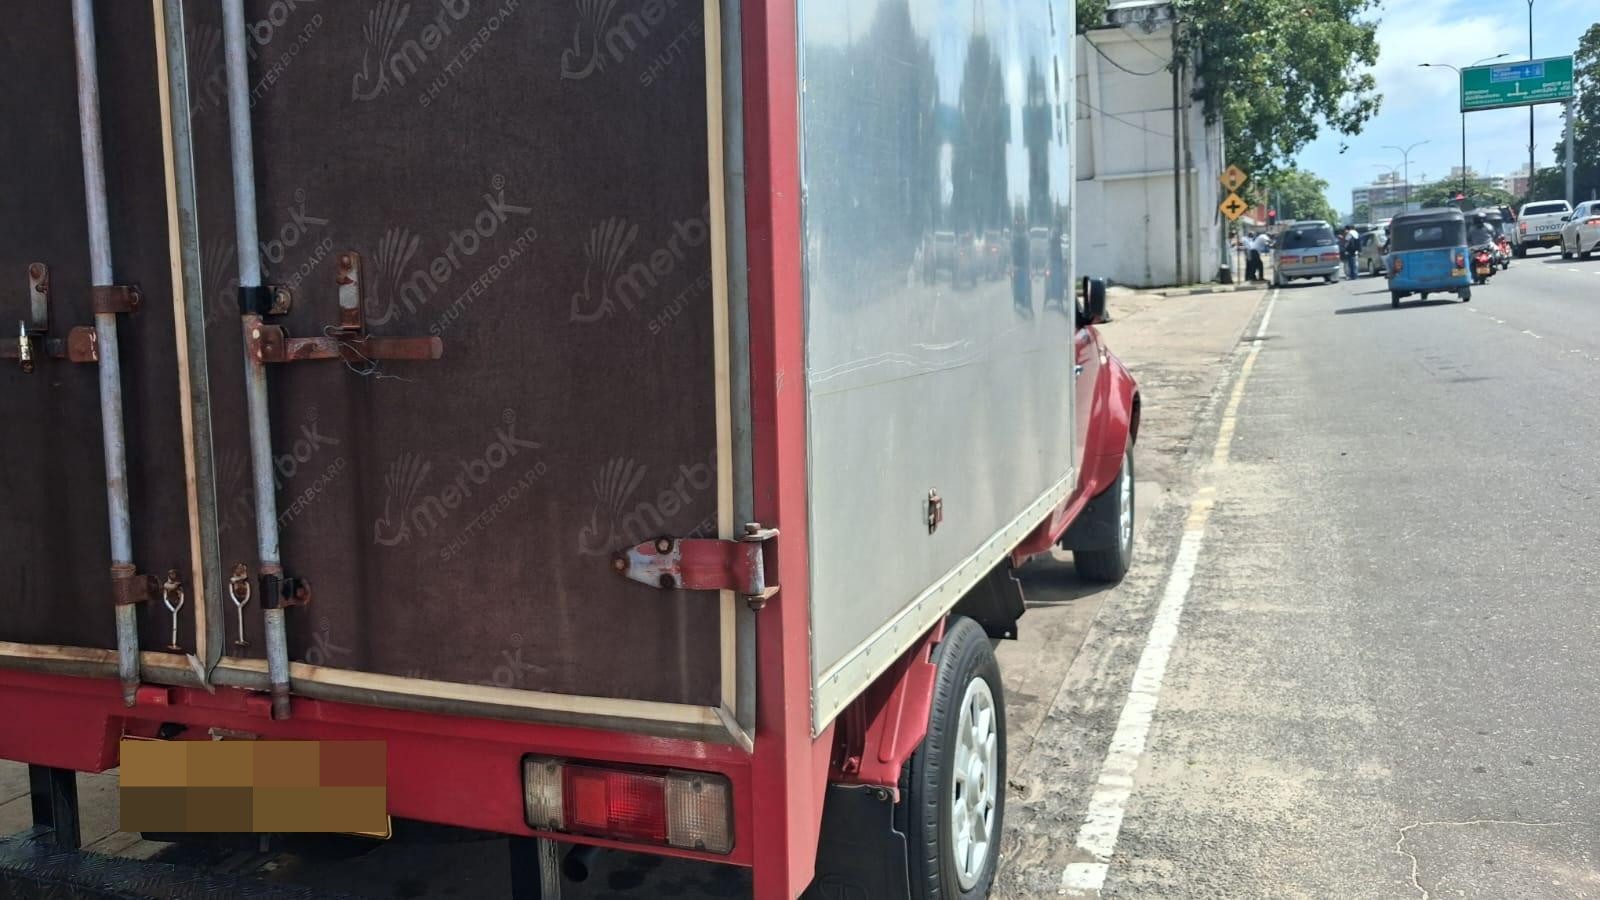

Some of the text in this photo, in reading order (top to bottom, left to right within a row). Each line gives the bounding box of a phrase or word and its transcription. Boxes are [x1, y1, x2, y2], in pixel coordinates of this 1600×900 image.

[249, 13, 323, 108] UTTERBOARD
[430, 226, 538, 337] SHUTTERBOARD
[615, 203, 710, 312] merb
[278, 456, 347, 531] TTERBOARD
[440, 461, 548, 562] SHUTTERBOARD
